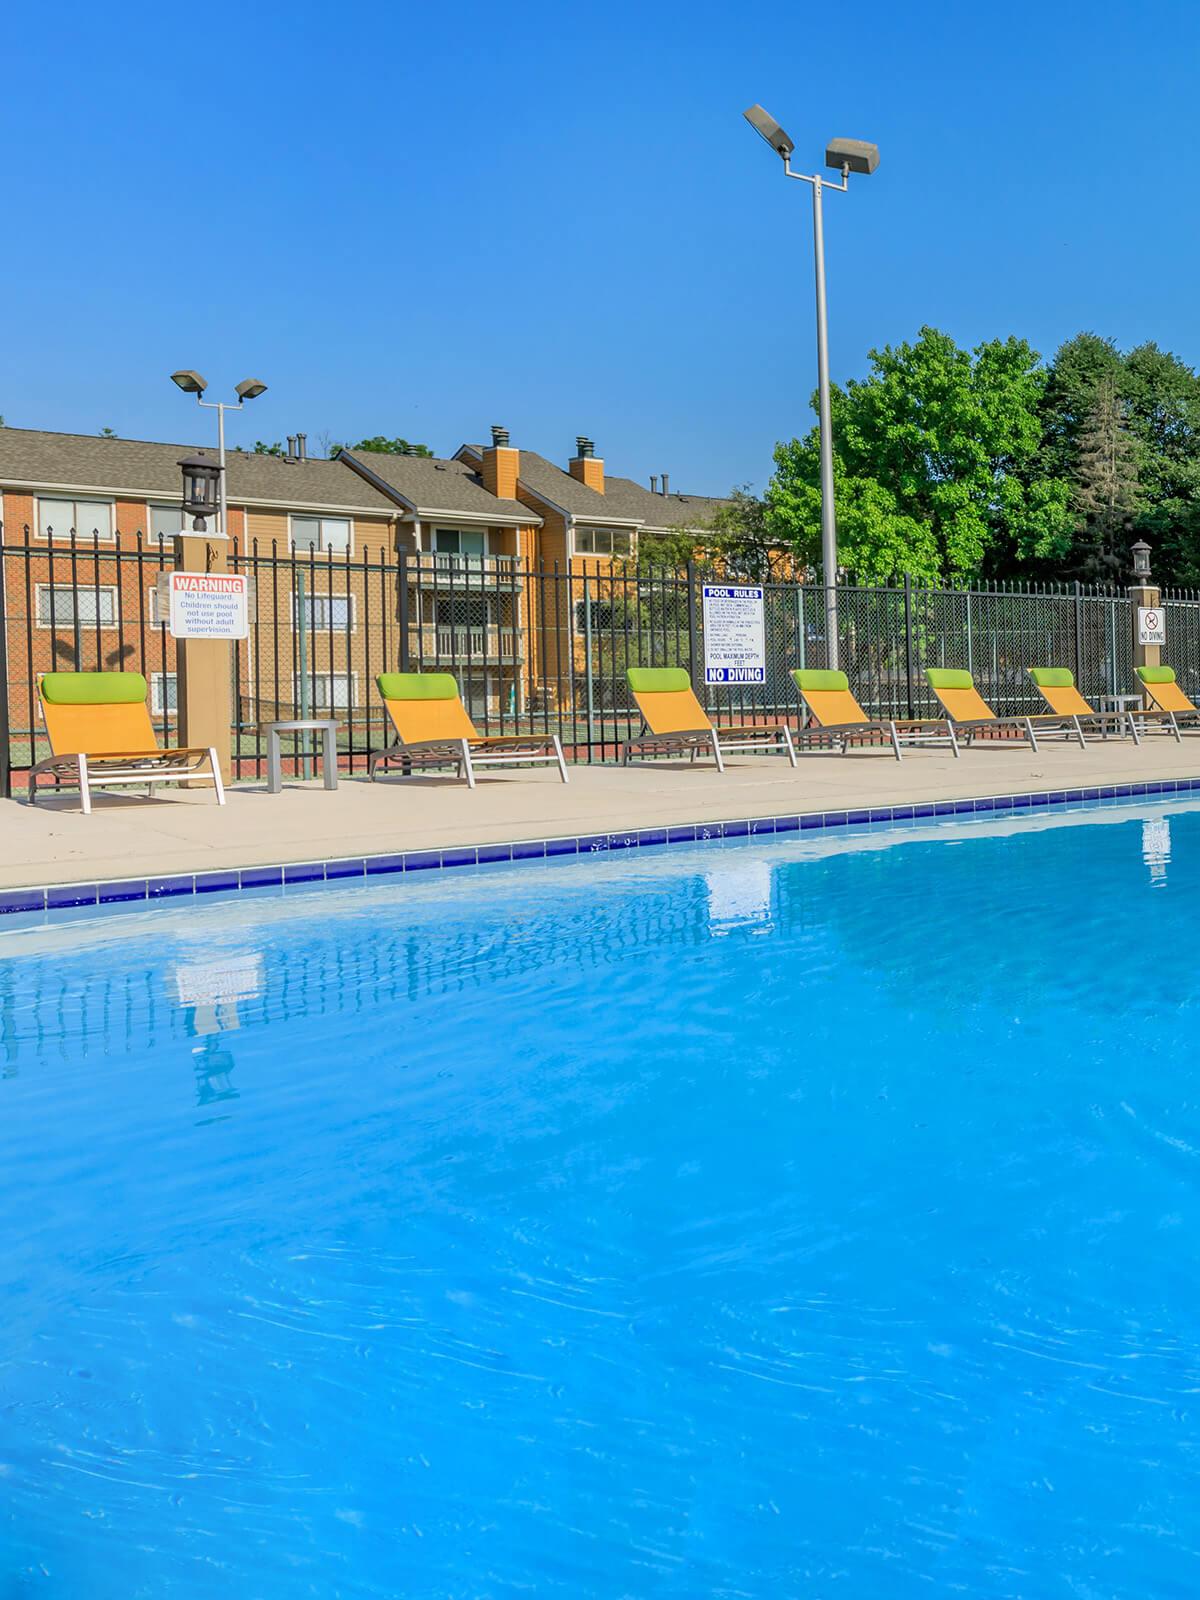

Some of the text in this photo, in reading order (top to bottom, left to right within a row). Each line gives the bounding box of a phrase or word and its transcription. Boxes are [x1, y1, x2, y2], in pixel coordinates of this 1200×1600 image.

[175, 577, 242, 592] WARNING
[185, 592, 195, 600] No
[708, 589, 759, 598] POOL RULES
[180, 601, 239, 610] Children should
[709, 668, 762, 681] NO DIVING
